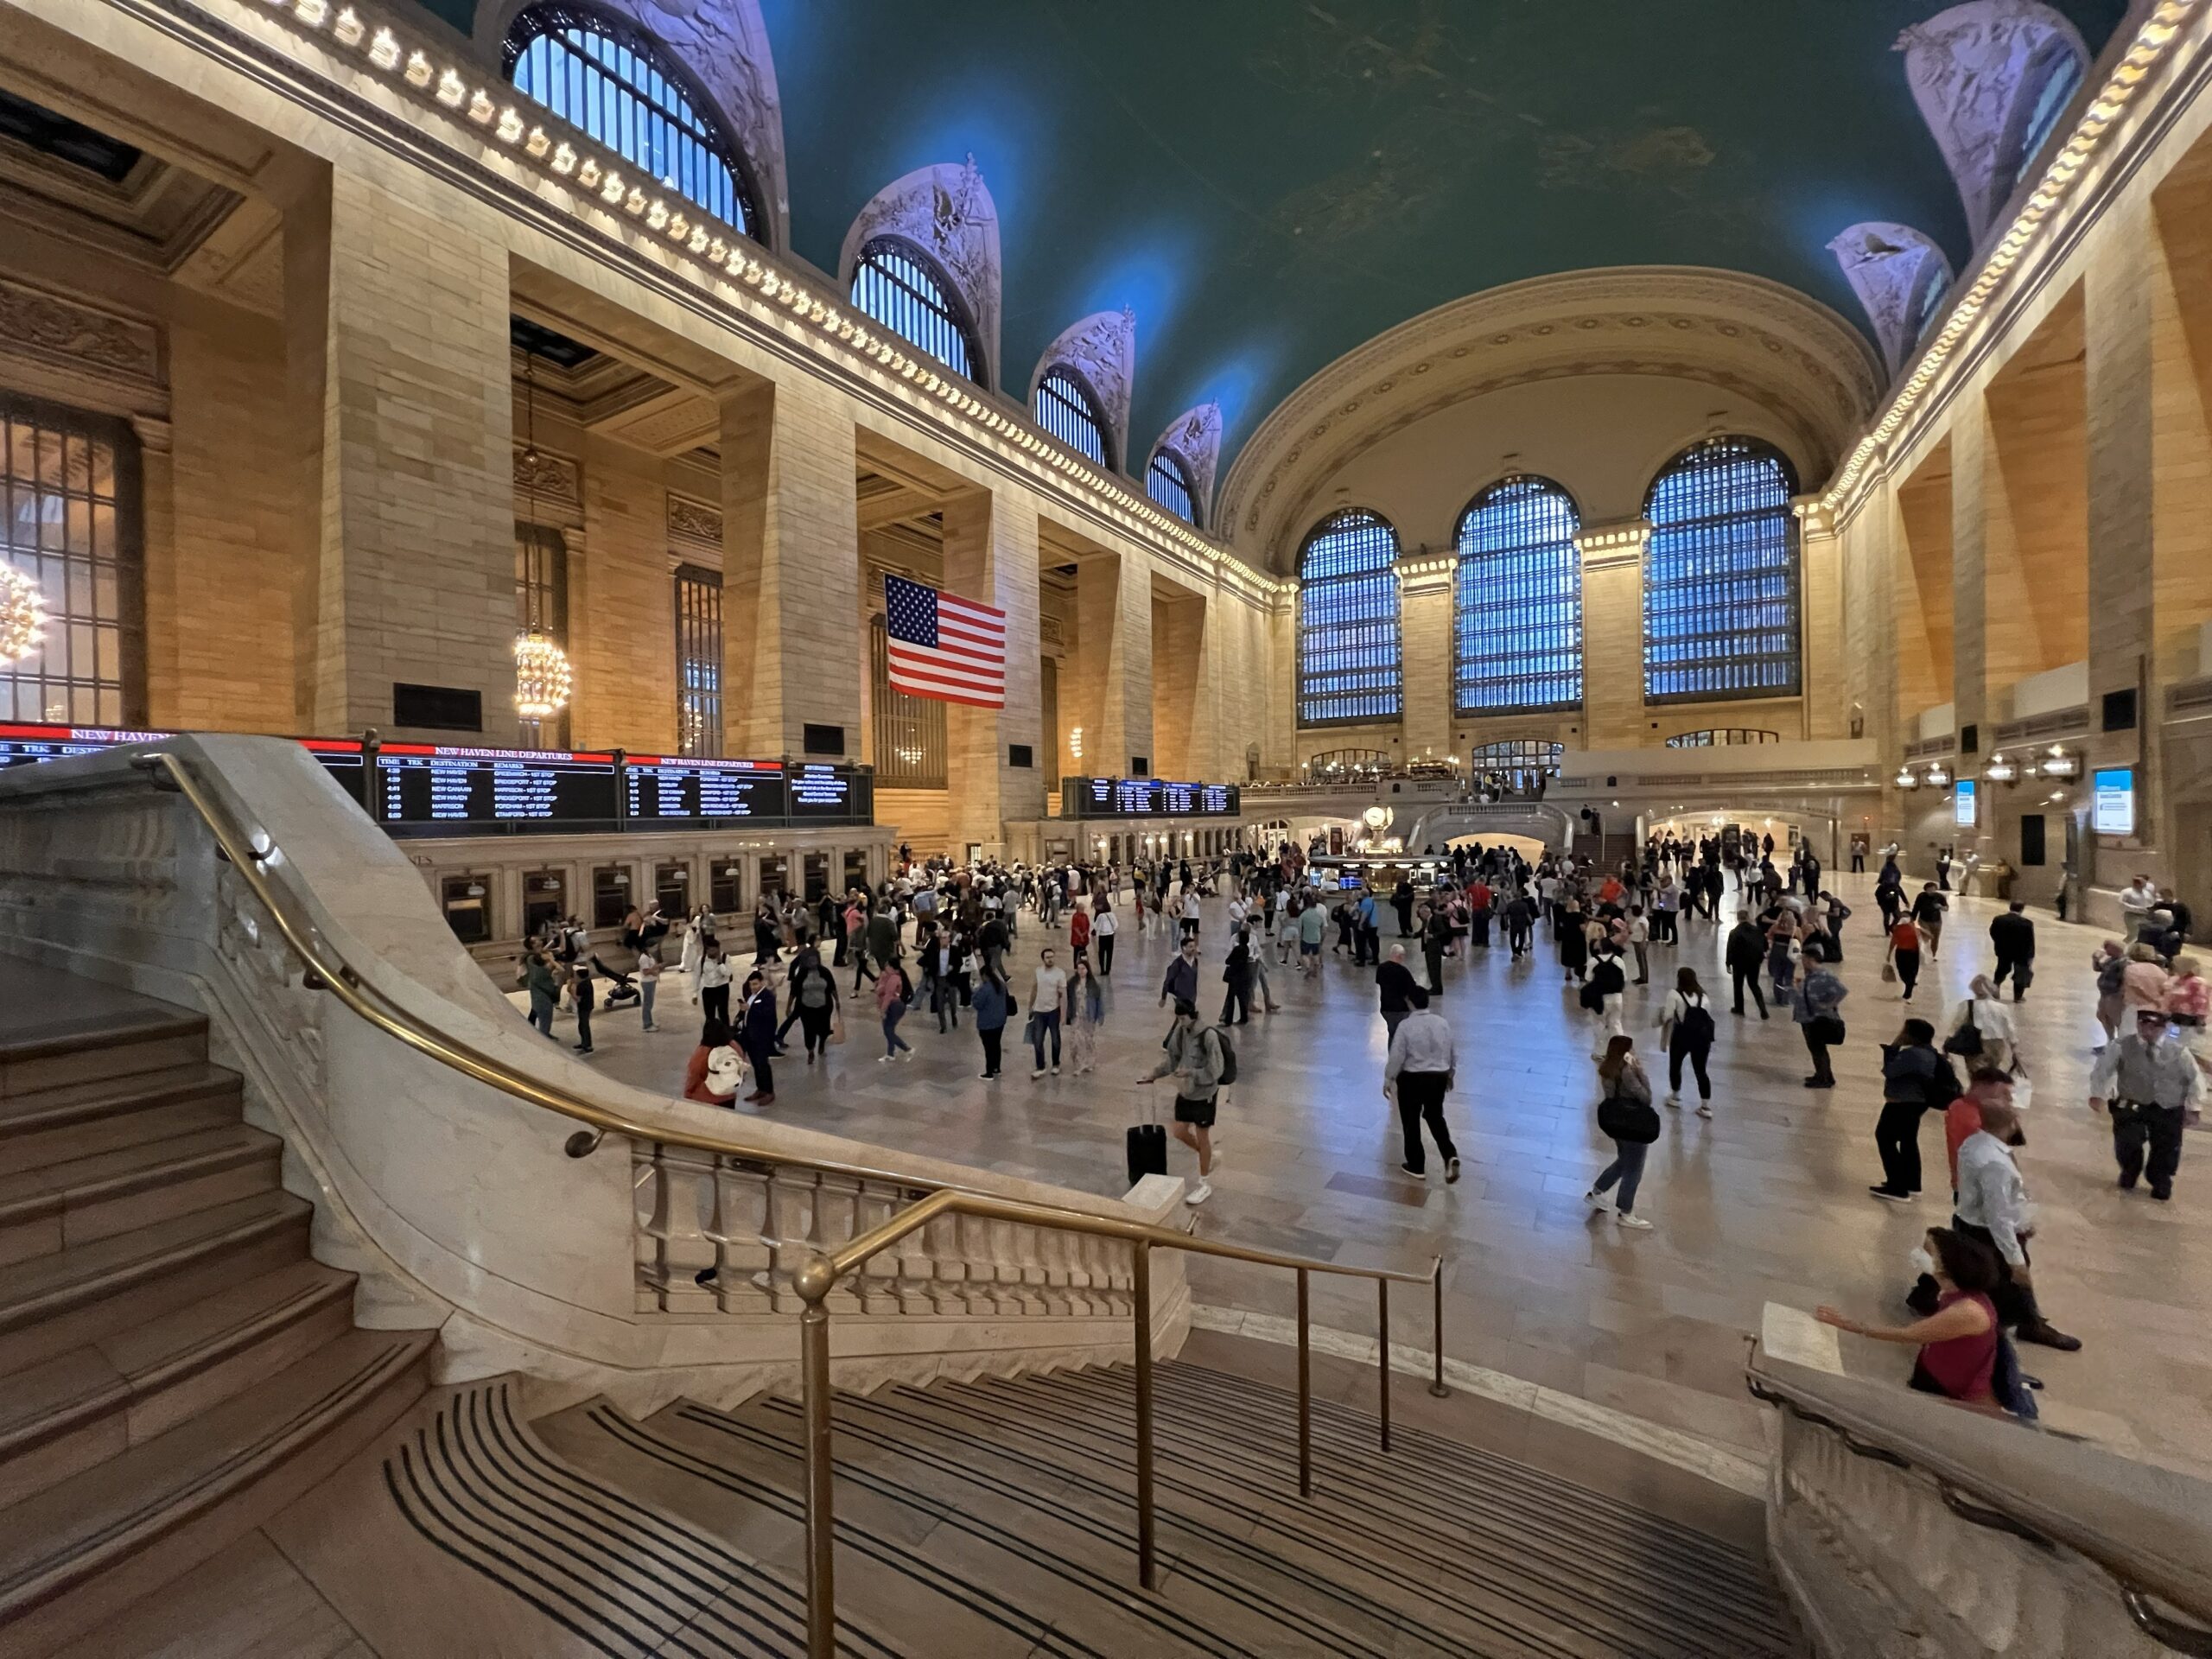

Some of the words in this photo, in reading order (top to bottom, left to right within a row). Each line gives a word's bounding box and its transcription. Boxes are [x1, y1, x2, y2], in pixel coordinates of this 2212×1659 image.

[71, 729, 111, 741] NEW
[435, 747, 459, 755] NEW
[461, 747, 494, 758] HAVEN
[518, 751, 573, 760] DEPARTURES
[429, 760, 479, 768] DESTINATION
